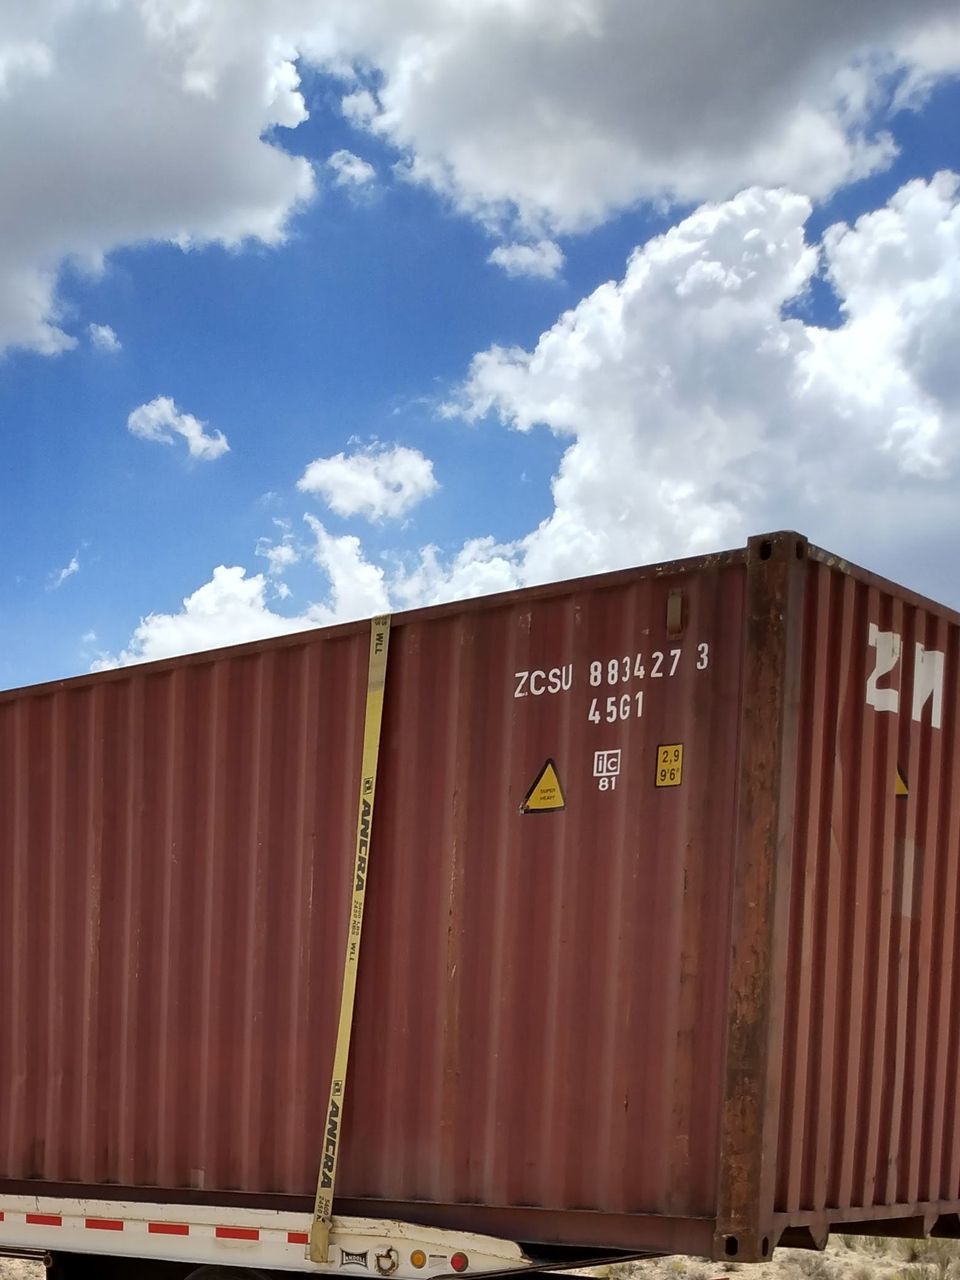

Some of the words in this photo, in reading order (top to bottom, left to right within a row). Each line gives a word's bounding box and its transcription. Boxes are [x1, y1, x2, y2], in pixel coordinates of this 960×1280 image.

[375, 632, 384, 655] WLL
[514, 663, 573, 698] ZCSU
[589, 648, 682, 688] 883427
[696, 642, 710, 671] 3
[587, 691, 644, 725] 45G1
[661, 749, 680, 764] 2,9
[598, 776, 616, 791] 81
[355, 798, 372, 892] ANCRA
[349, 942, 357, 963] WLL
[320, 1099, 340, 1189] ANCRA
[317, 1195, 325, 1214] 2450
[323, 1198, 331, 1216] 5400
